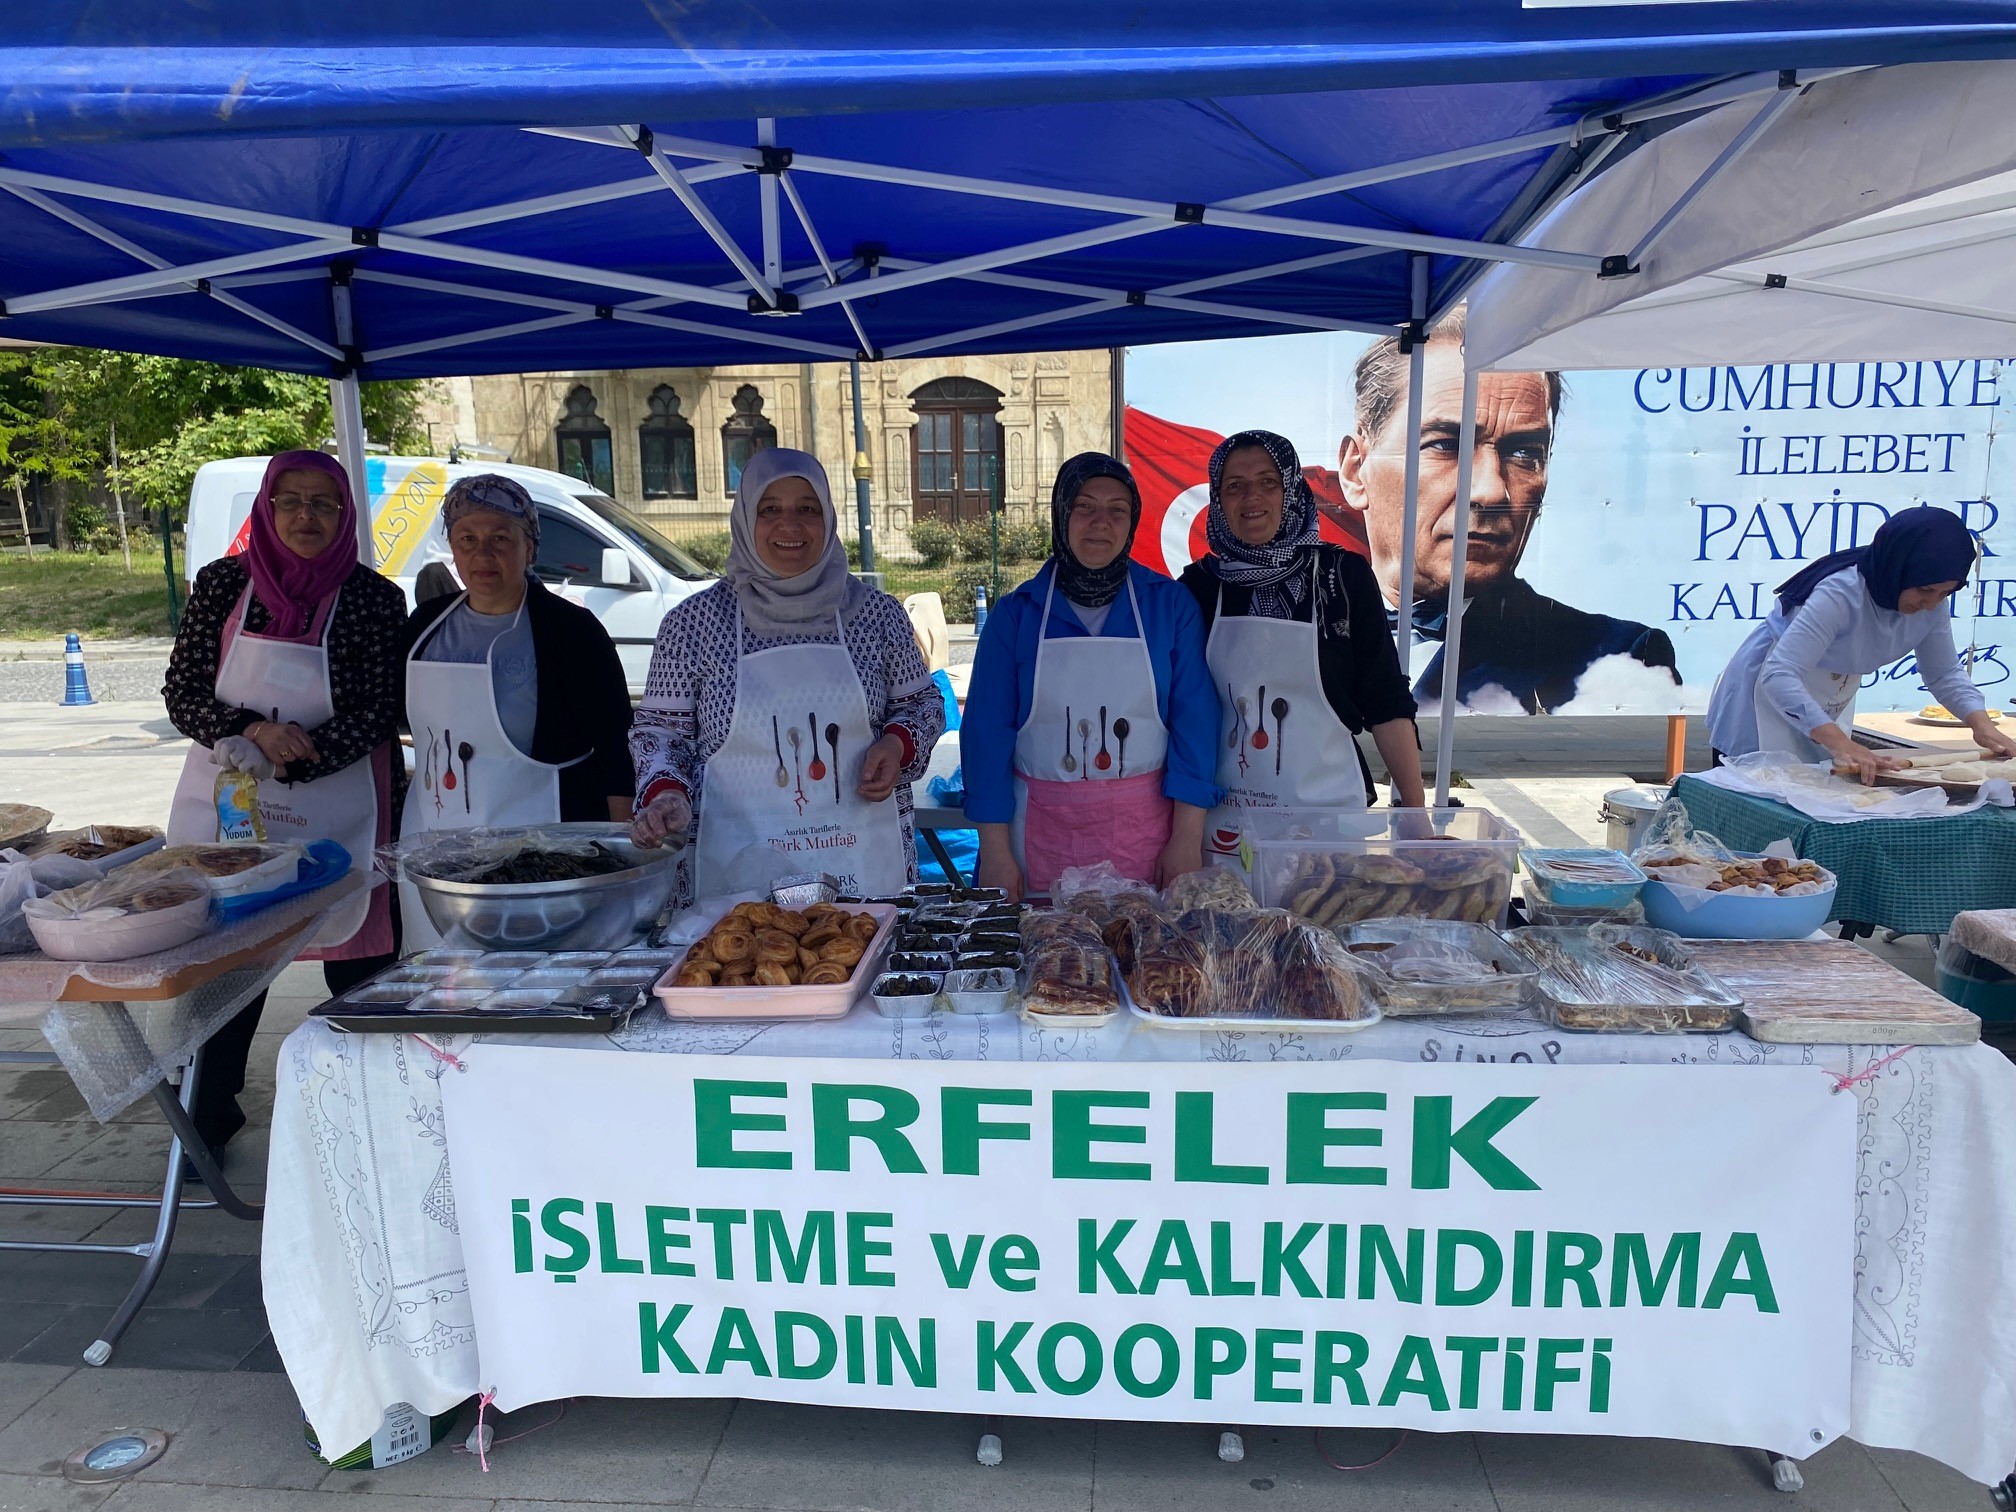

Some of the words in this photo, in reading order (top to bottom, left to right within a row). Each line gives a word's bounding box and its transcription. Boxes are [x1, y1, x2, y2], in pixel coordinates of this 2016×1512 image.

[1736, 426, 1965, 476] İLELEBET
[1692, 488, 2002, 561] PAYİDR
[259, 809, 308, 828] Mutfağı
[1222, 796, 1241, 808] ürk
[222, 823, 253, 840] YUDUM
[784, 827, 808, 836] Asırlık
[808, 823, 841, 834] Tariflerle
[805, 832, 857, 850] Mutfağı
[695, 1080, 1540, 1190] ERFELEK
[512, 1198, 895, 1285] İŞLETME
[930, 1233, 1040, 1292] ve
[1078, 1219, 1780, 1314] KALKINDIRMA
[638, 1301, 938, 1390] KADIN
[976, 1320, 1613, 1414] KOOPERATİFİ
